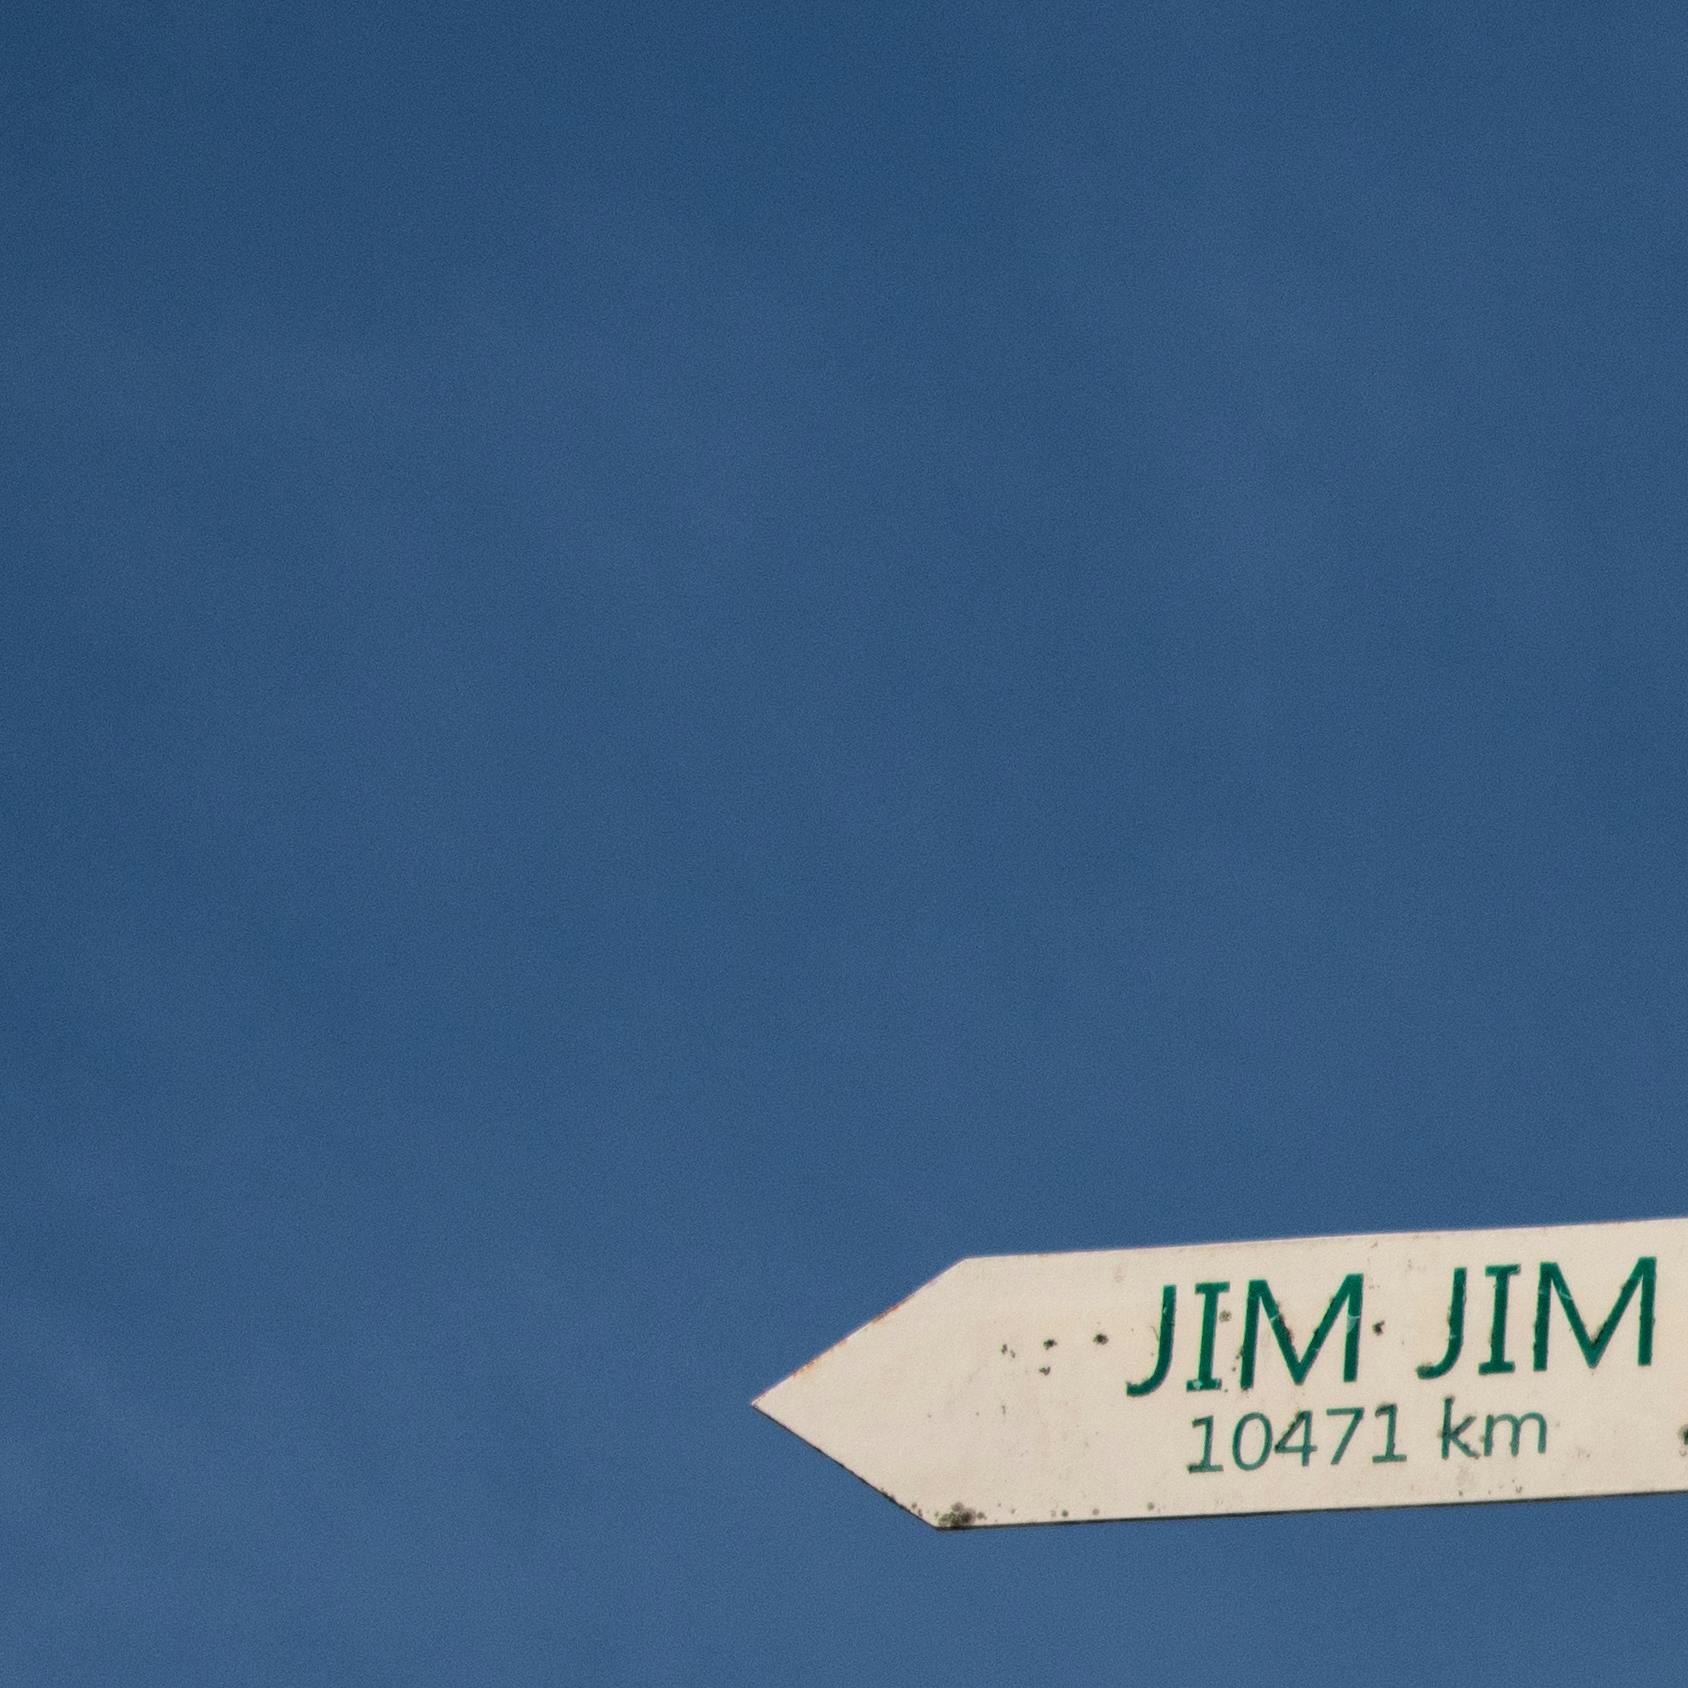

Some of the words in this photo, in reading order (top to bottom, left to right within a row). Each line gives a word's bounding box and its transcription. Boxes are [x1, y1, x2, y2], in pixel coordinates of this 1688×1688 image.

[1125, 1273, 1364, 1395] JIM
[1417, 1254, 1656, 1382] JIM
[1186, 1403, 1407, 1473] 10471
[1440, 1395, 1550, 1459] km
